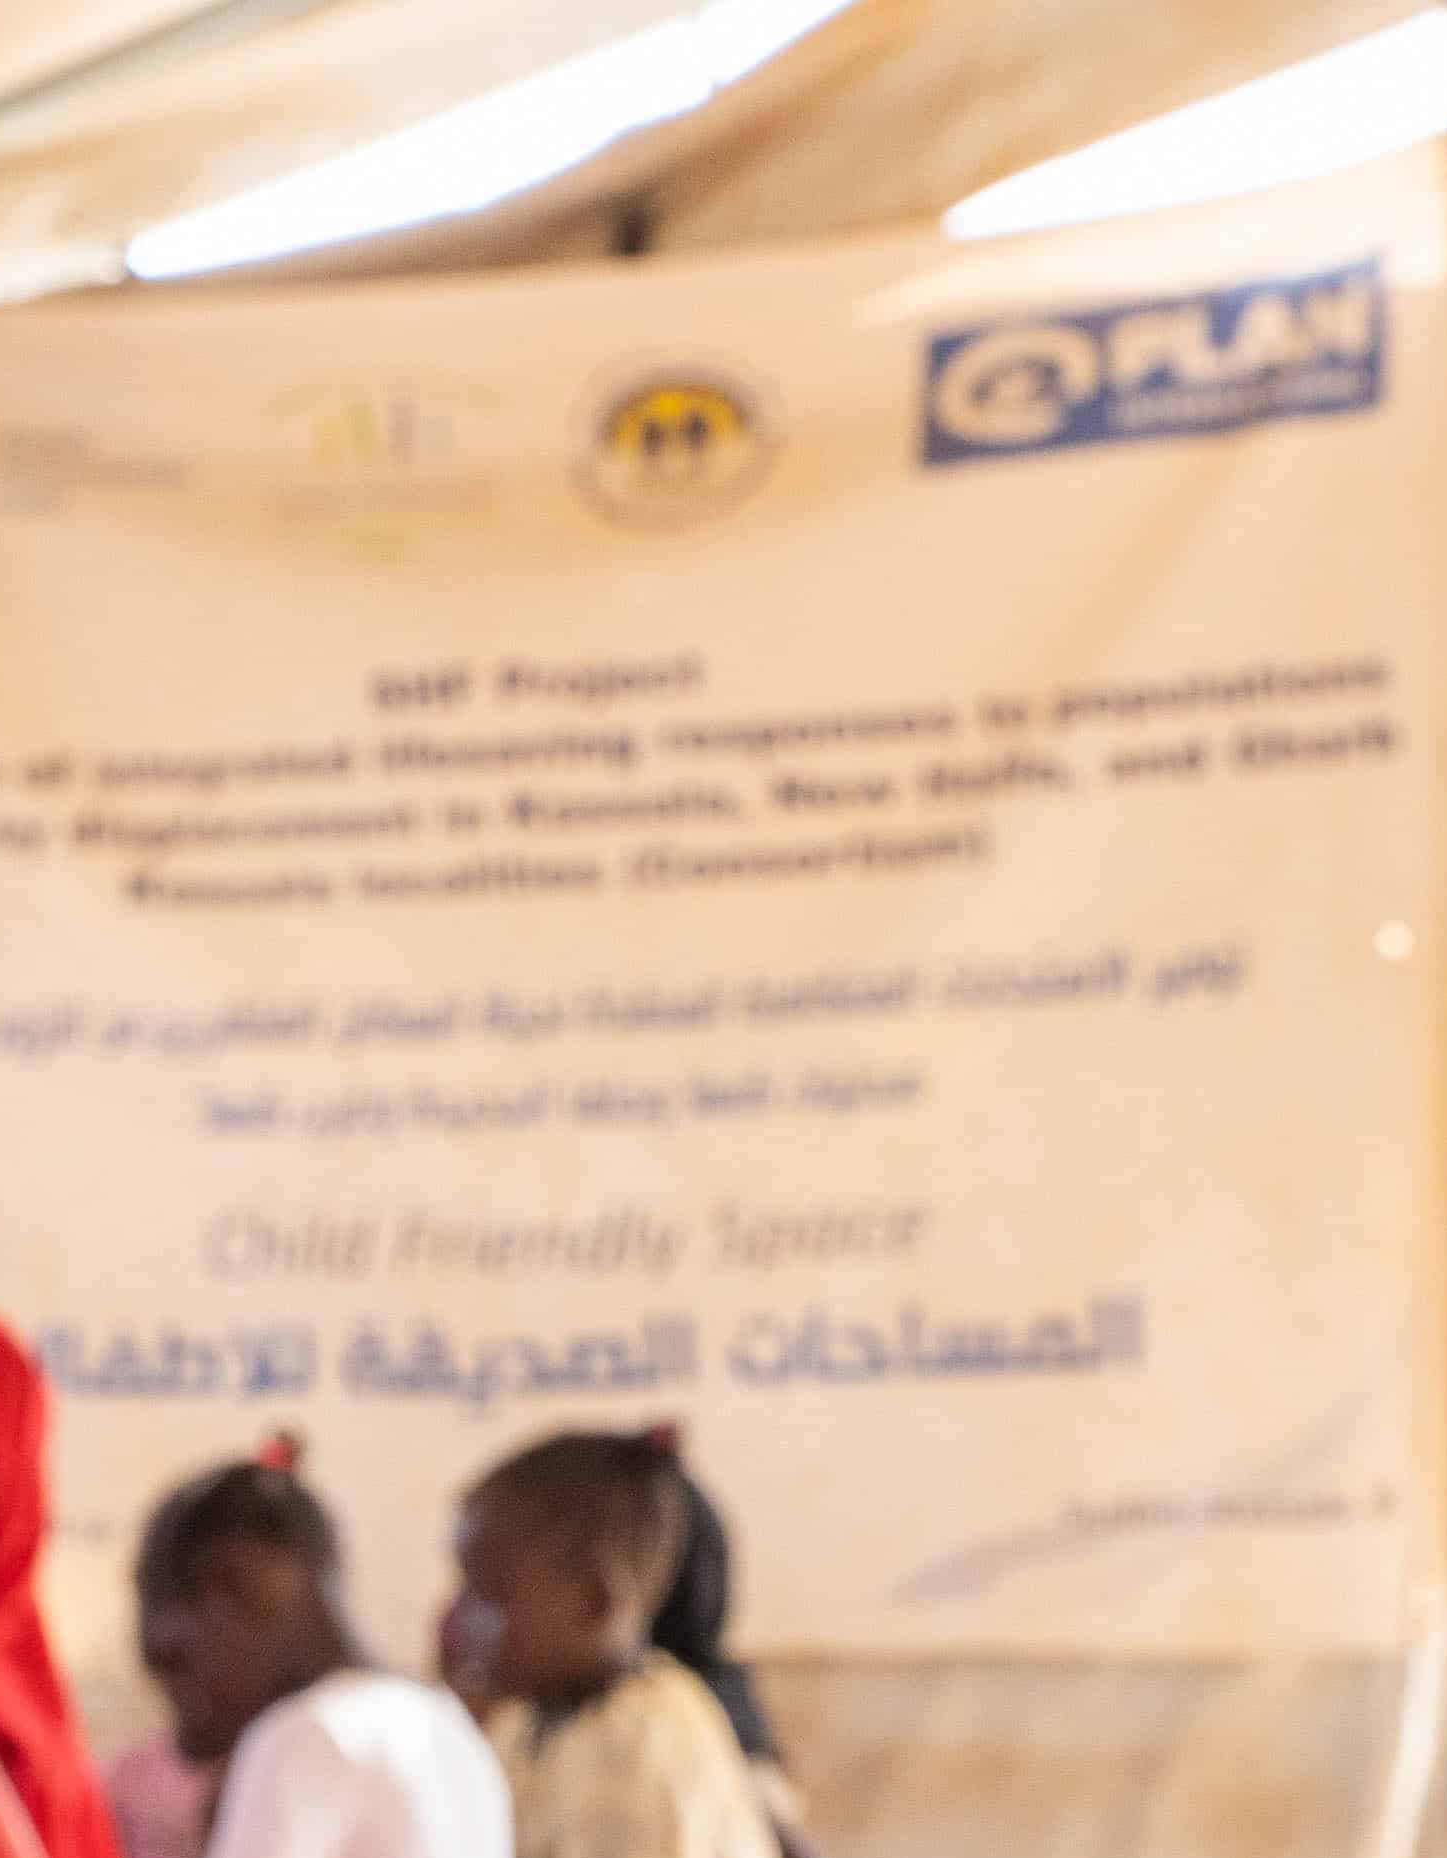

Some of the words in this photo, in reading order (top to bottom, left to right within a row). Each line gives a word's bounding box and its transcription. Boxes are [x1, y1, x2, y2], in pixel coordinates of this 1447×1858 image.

[203, 1202, 374, 1284] Child
[388, 1200, 685, 1284] Friendly
[711, 1192, 934, 1274] Space
[728, 1290, 1146, 1392] المساحات
